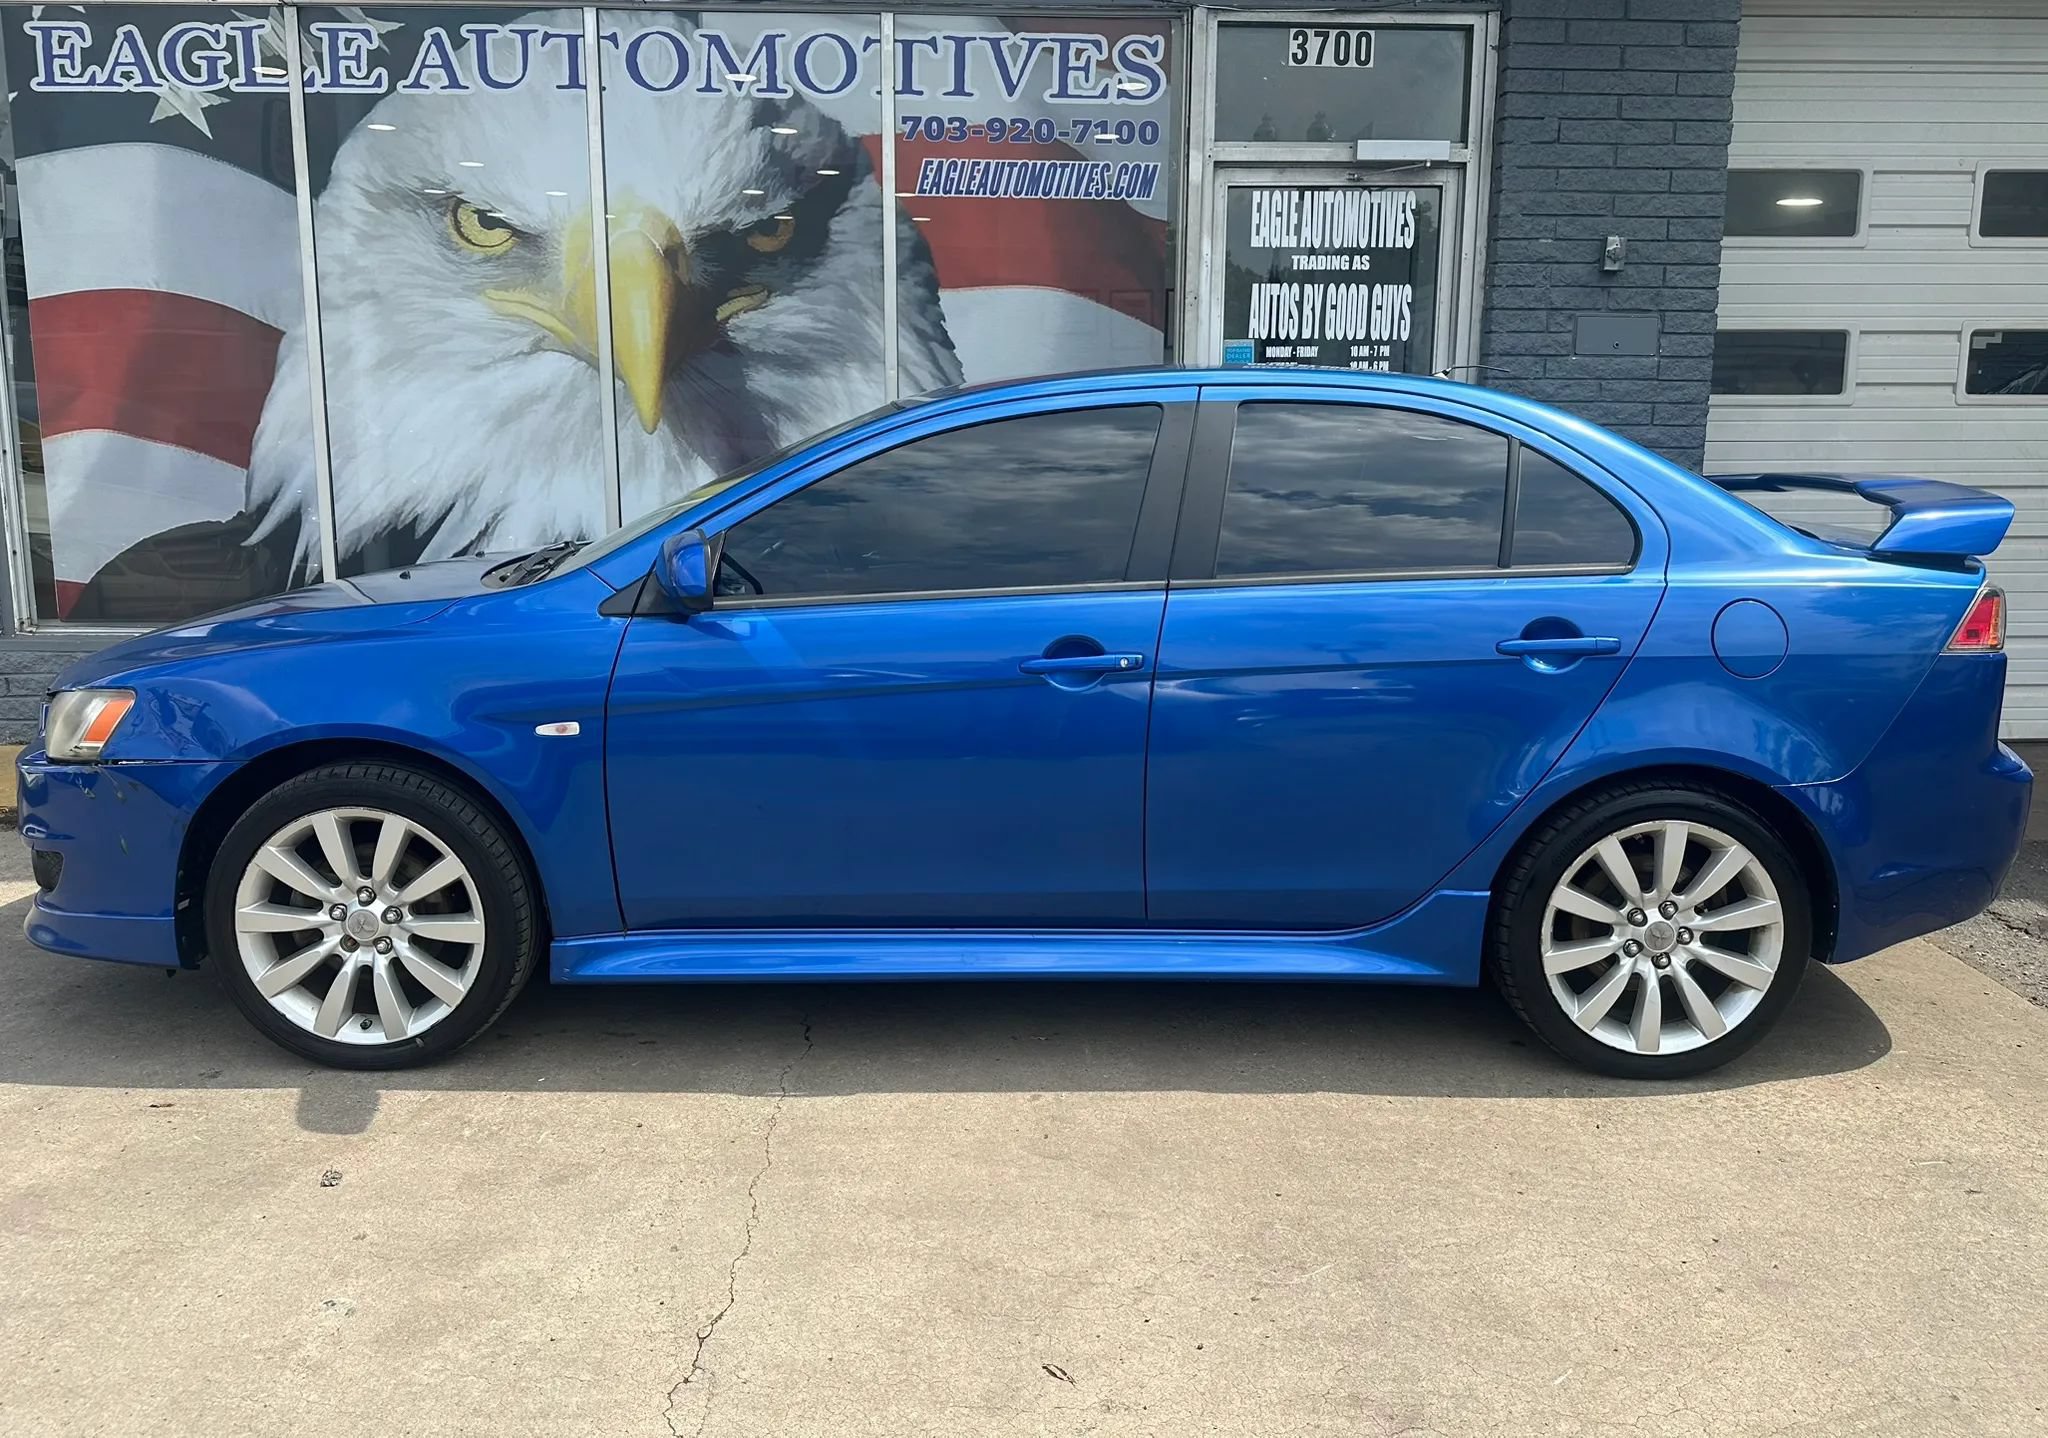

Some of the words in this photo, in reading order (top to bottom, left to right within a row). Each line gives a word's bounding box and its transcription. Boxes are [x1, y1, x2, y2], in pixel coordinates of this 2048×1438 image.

[24, 20, 389, 94] EAGLE
[398, 23, 1169, 105] AUTOMOTIVES
[1291, 29, 1373, 67] 3700
[900, 115, 1161, 147] 703-920-7100
[915, 157, 1162, 201] EAGLEAUTOMOTIVES.COM
[1250, 190, 1299, 249] EAGLE
[1300, 190, 1416, 250] AUTOMOTIVES
[1291, 255, 1350, 271] TRADING
[1352, 255, 1370, 271] AS
[1248, 282, 1300, 341] AUTOS
[1301, 283, 1324, 340] BY
[1325, 282, 1369, 341] GOOD
[1370, 283, 1413, 342] GUYS
[1265, 346, 1292, 358] MONDAY
[1296, 346, 1319, 358] FRIDAY
[1350, 346, 1358, 357] 10
[1359, 346, 1369, 357] AM
[1373, 345, 1378, 357] 7
[1379, 345, 1390, 357] PM
